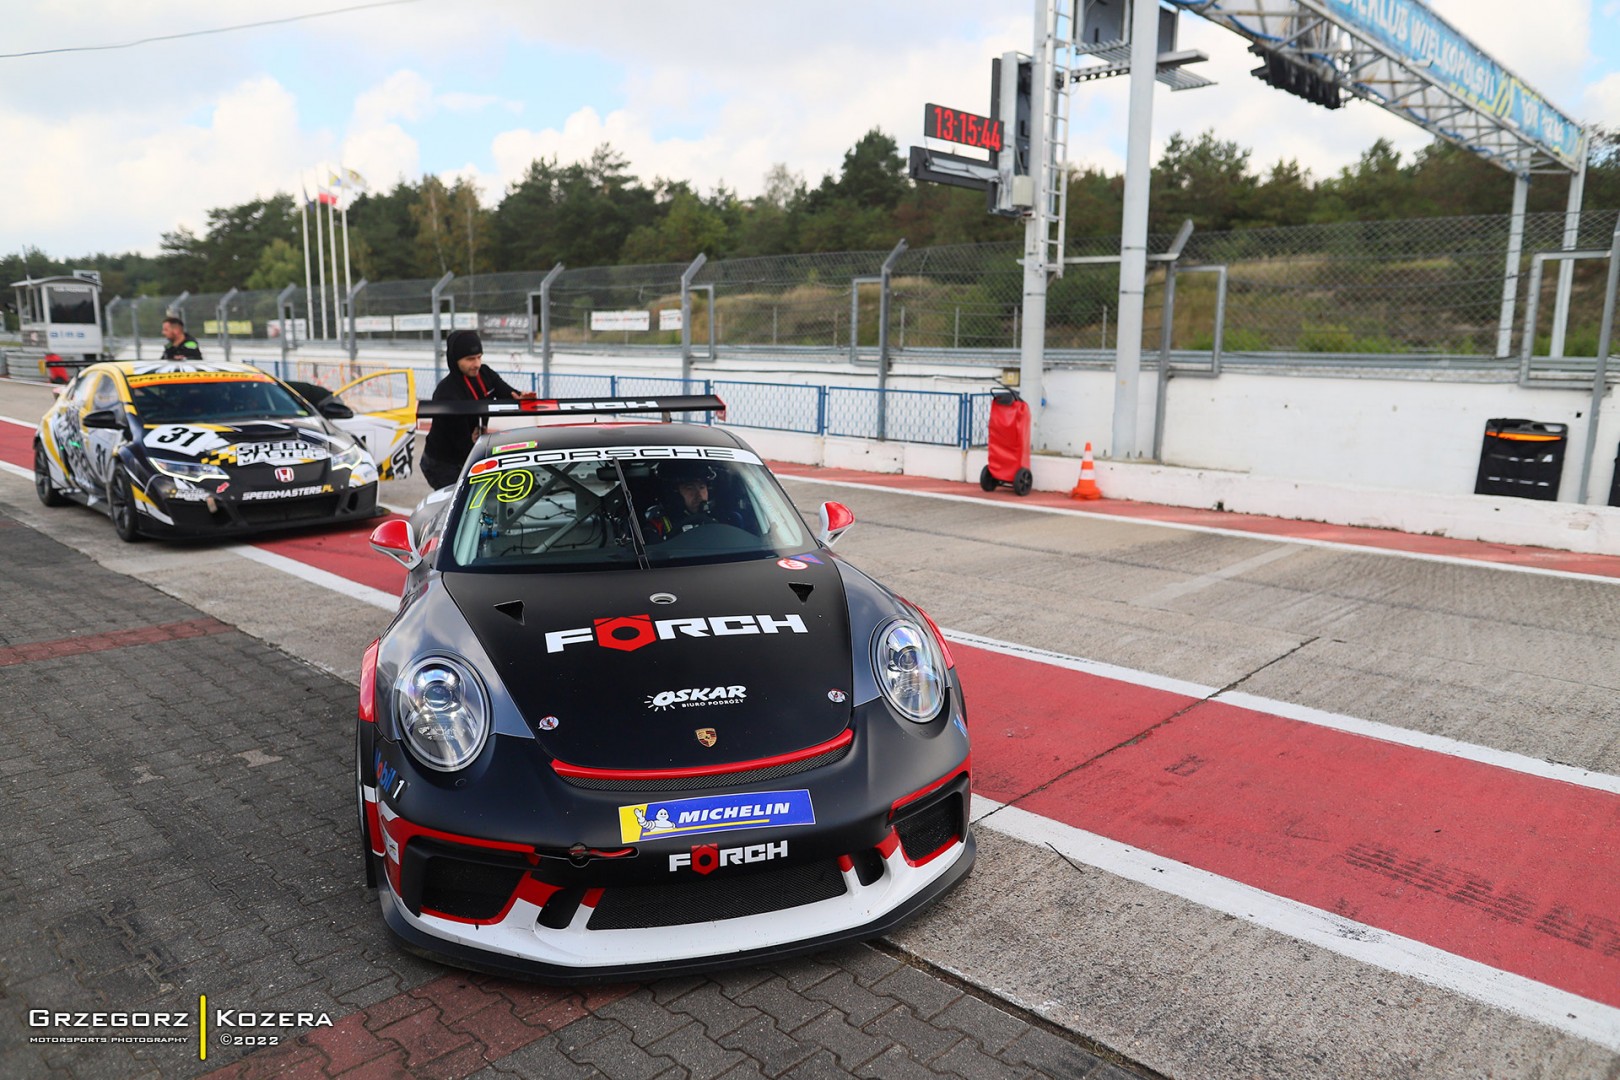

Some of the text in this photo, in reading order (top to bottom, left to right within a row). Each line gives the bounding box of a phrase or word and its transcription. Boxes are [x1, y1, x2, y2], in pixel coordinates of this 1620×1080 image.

[934, 106, 1001, 152] 13:15:44
[156, 426, 206, 448] 31
[498, 447, 735, 468] PORSCHE
[242, 484, 334, 501] SPEEDMASTERS.PL
[468, 469, 534, 510] 79
[652, 685, 747, 706] OSKAR
[681, 700, 706, 708] BIURO
[679, 802, 791, 824] MICHELIN
